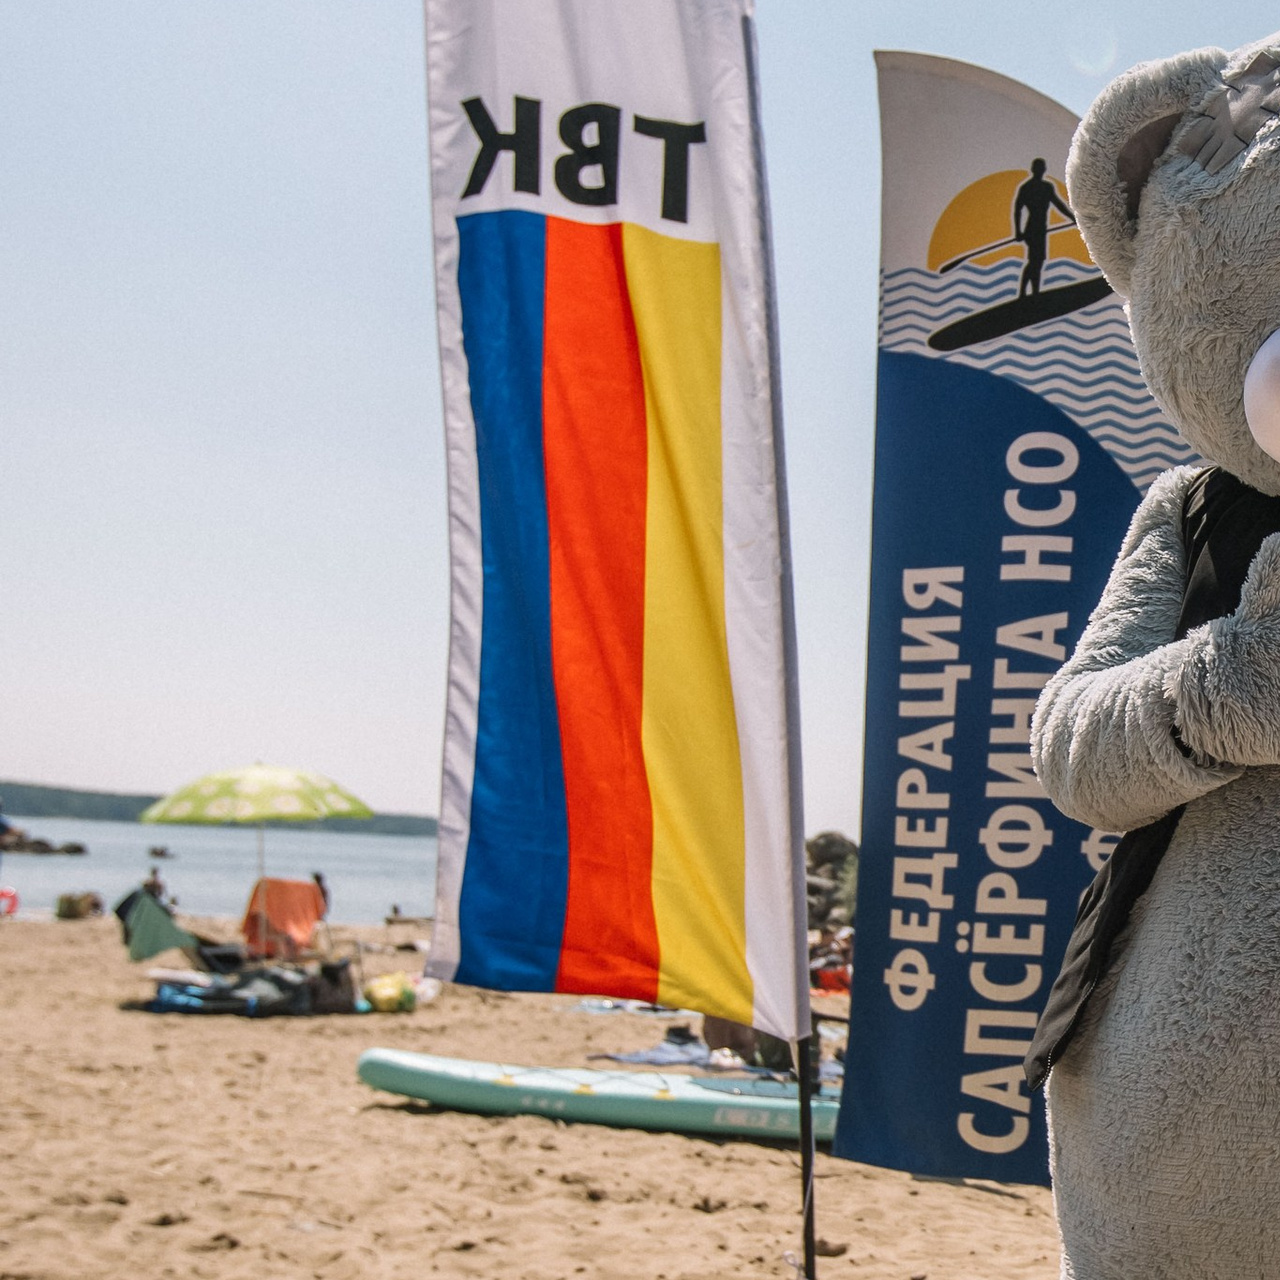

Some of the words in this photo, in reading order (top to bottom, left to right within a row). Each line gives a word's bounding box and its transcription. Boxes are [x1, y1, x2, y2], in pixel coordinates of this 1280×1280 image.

[1000, 431, 1080, 582] НСО
[883, 565, 972, 1011] ФЕДЕРАЦИЯ
[955, 611, 1069, 1154] САПСЁРФИНГА
